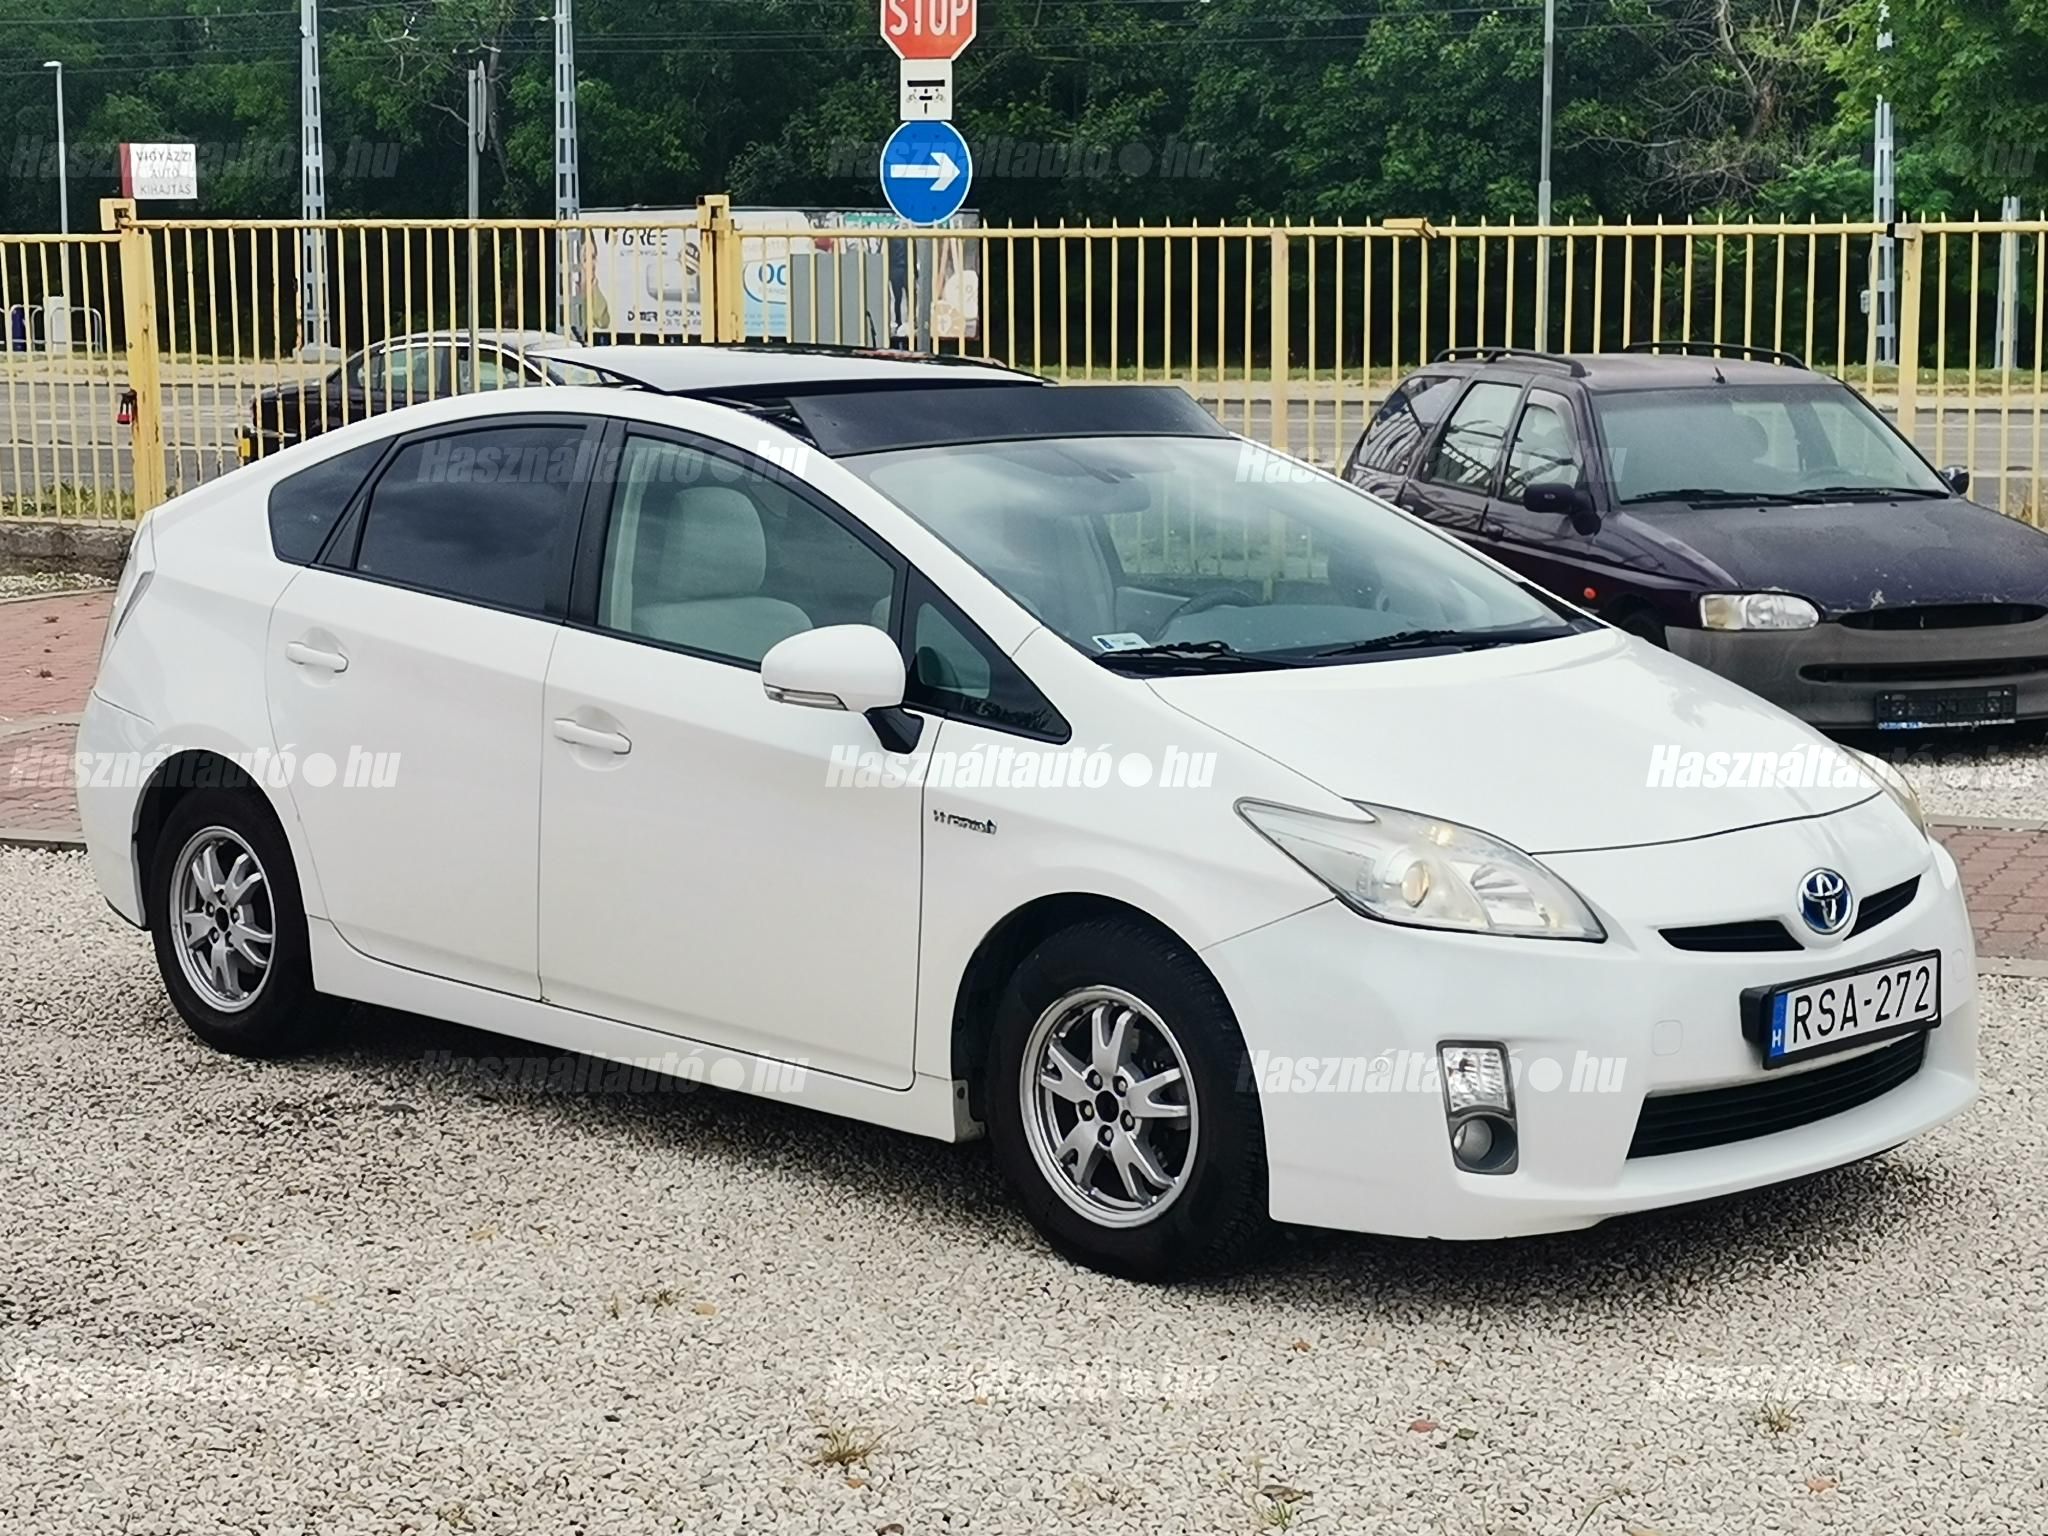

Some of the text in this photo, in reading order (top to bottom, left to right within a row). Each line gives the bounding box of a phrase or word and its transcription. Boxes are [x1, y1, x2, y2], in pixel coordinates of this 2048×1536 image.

[889, 0, 970, 36] STOP
[1771, 966, 1930, 1049] H RSA-272
